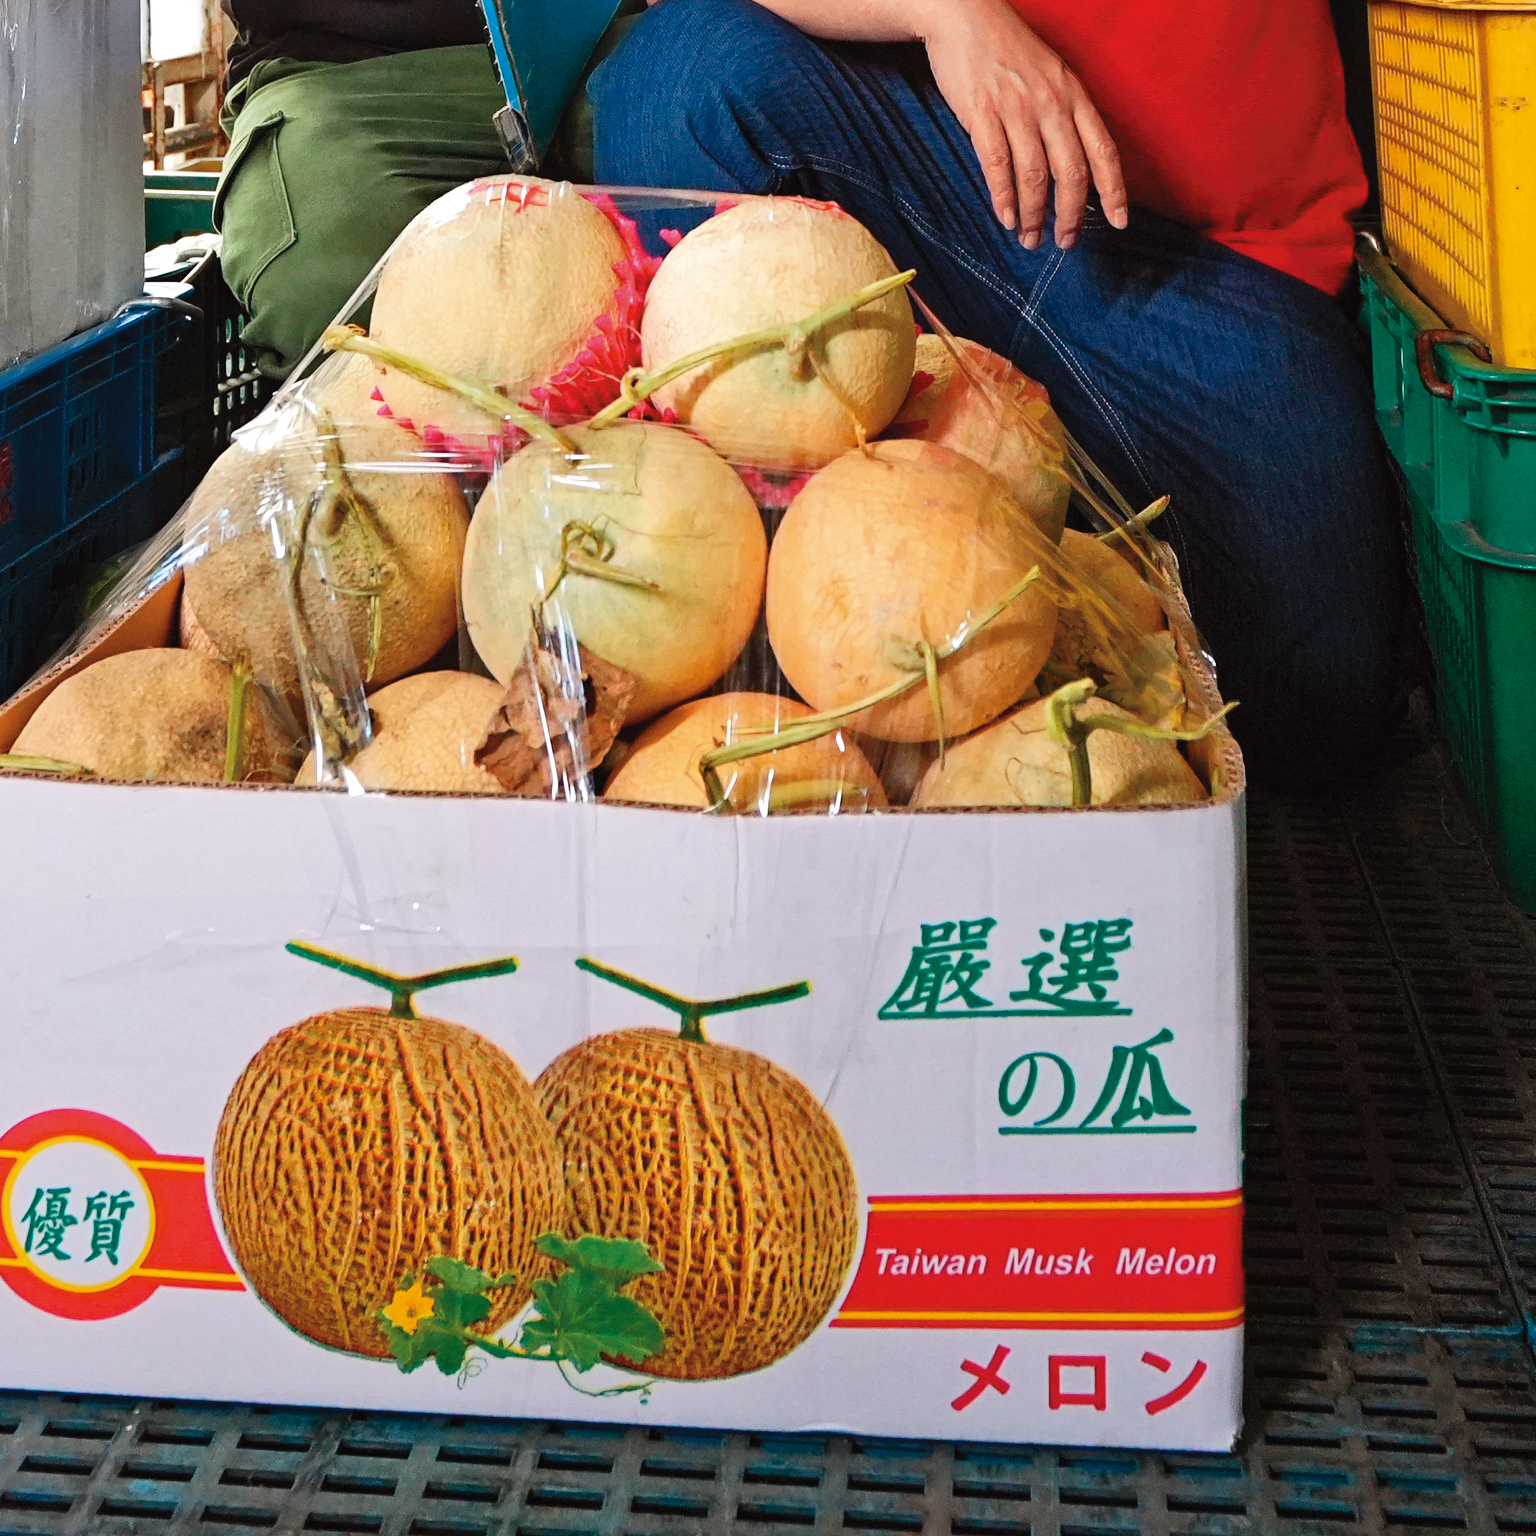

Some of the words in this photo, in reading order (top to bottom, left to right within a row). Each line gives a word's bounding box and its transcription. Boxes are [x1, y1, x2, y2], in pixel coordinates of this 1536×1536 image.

[880, 917, 1133, 1017] 嚴選
[997, 1028, 1192, 1129] の瓜
[20, 1186, 136, 1267] 優質
[875, 1247, 988, 1276] Taiwan
[1004, 1247, 1094, 1276] Musk
[1115, 1247, 1217, 1276] Melon
[950, 1344, 1208, 1416] メロン
